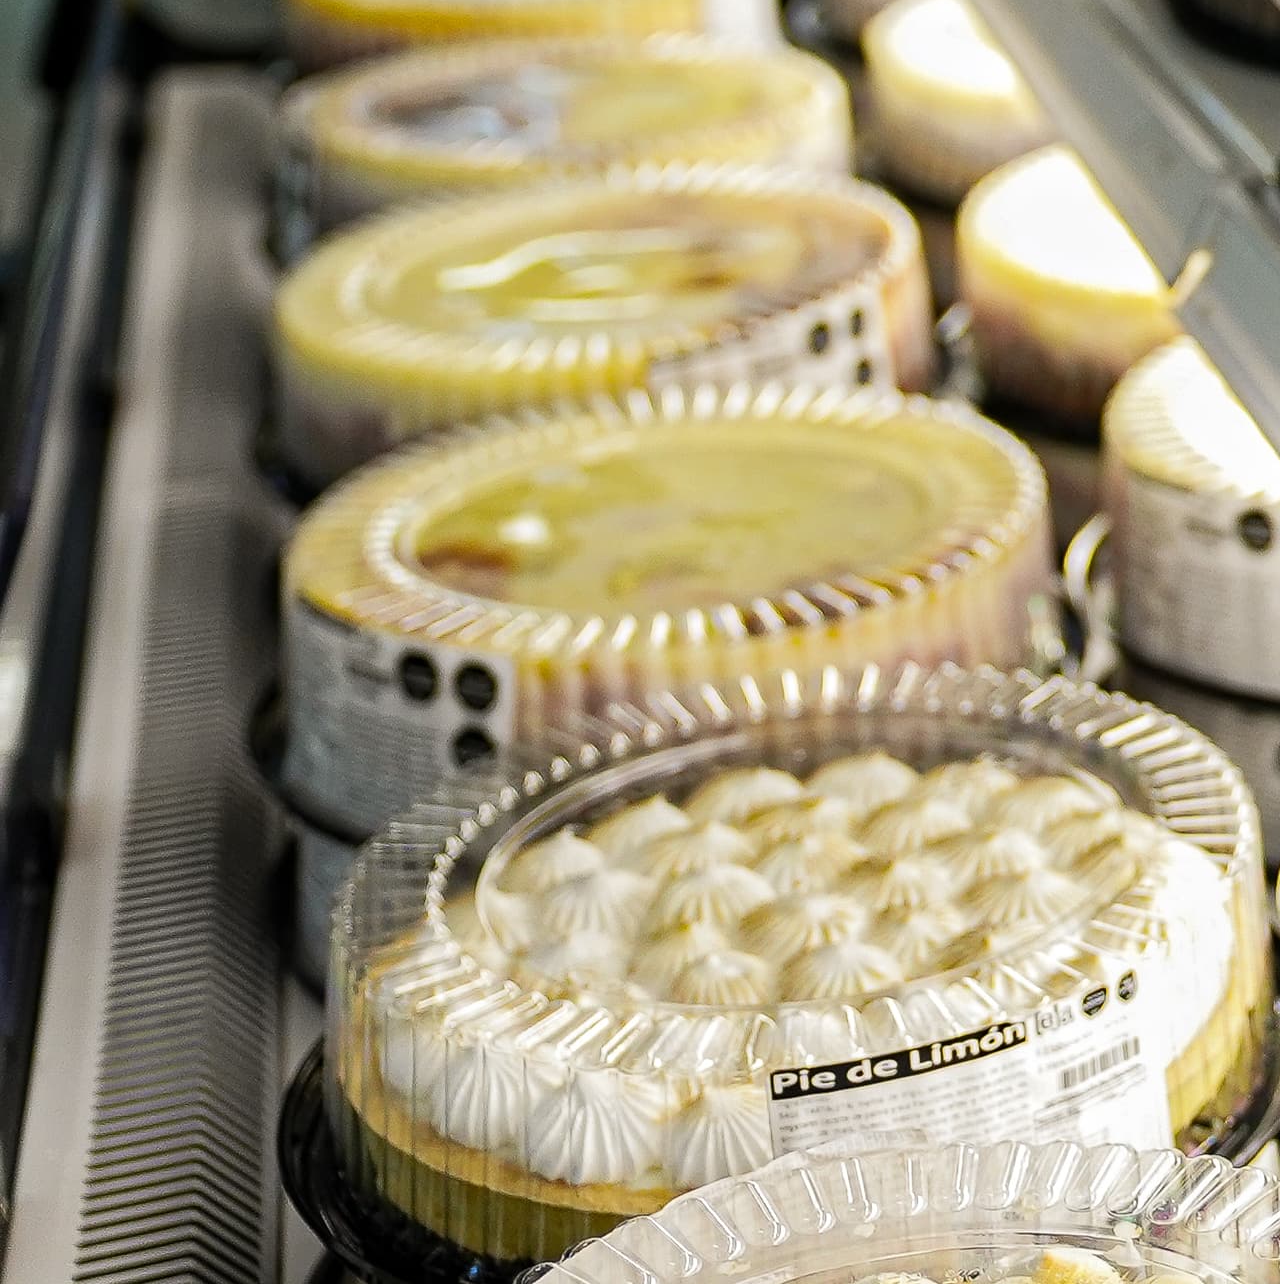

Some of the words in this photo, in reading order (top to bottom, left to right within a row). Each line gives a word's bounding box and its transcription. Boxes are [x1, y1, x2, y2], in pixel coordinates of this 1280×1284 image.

[772, 1069, 837, 1096] Pie
[846, 1058, 897, 1084] de
[909, 1020, 1026, 1072] Limón
